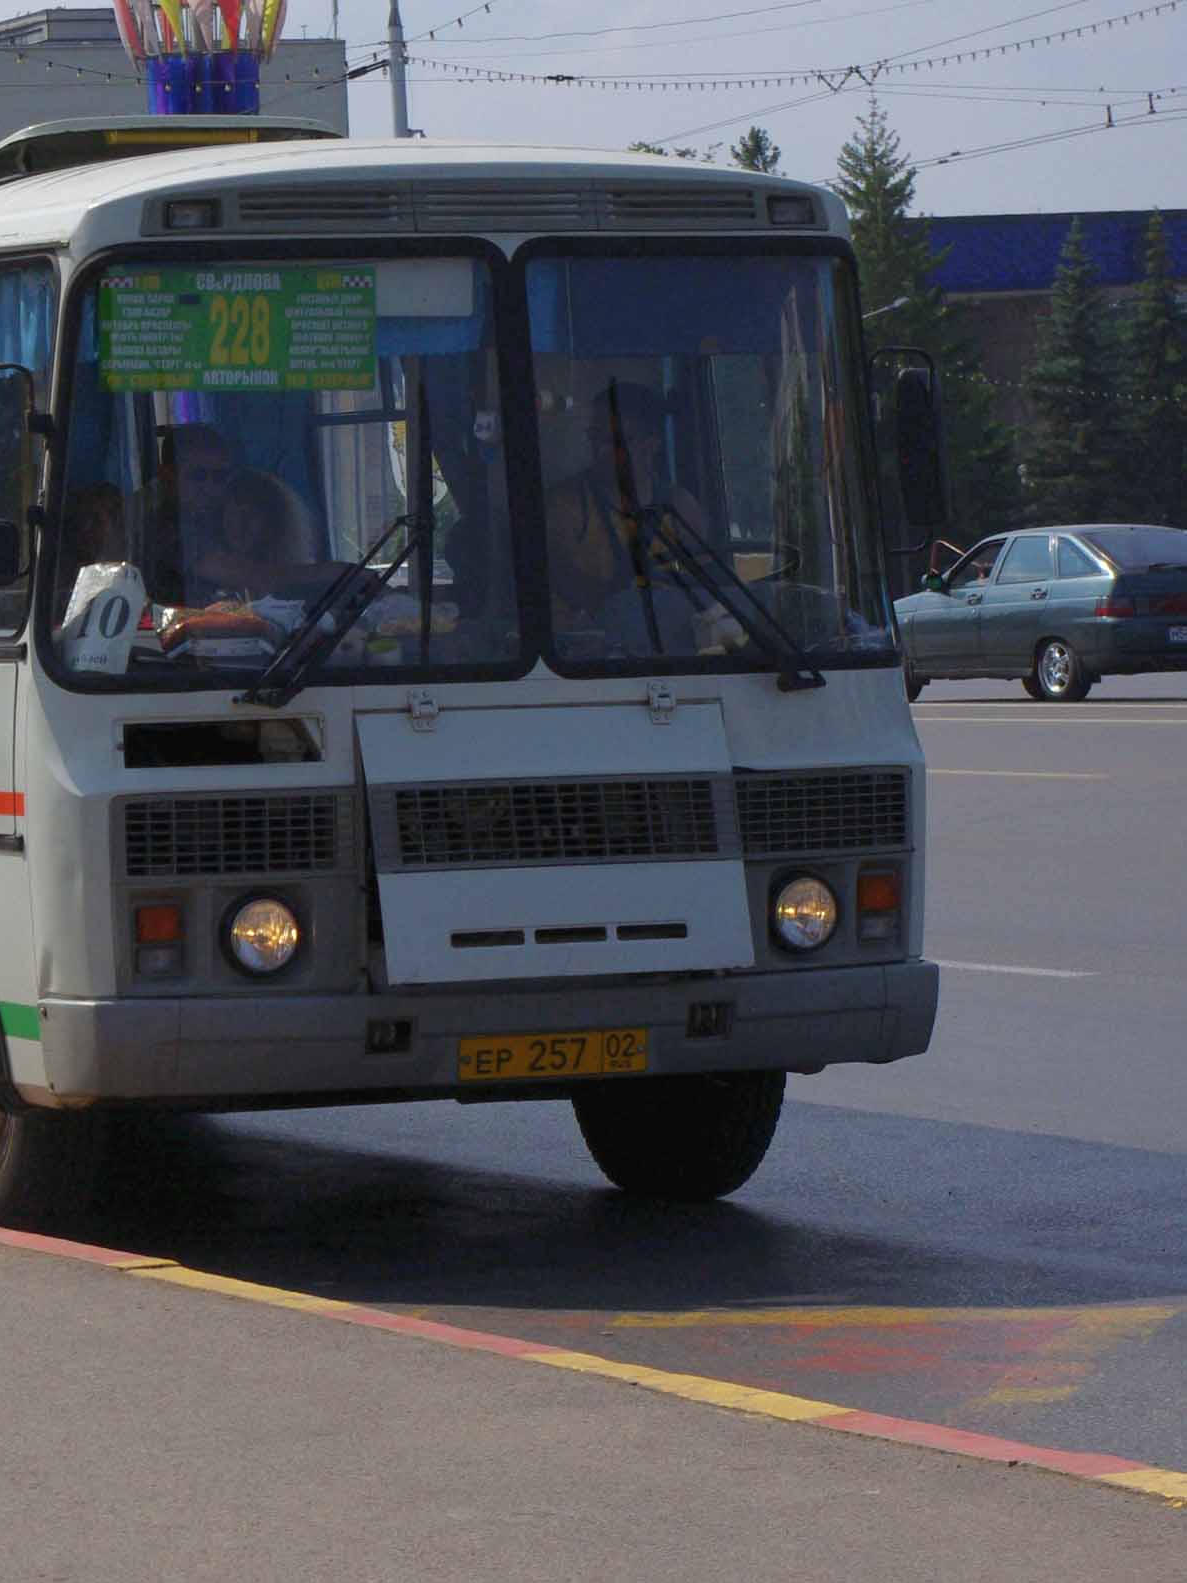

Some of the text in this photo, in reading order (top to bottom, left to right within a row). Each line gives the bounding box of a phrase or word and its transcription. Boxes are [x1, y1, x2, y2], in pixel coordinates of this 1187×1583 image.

[207, 293, 271, 366] 228
[77, 596, 131, 639] 10
[475, 1037, 587, 1074] ЕР 257
[606, 1034, 636, 1057] 02
